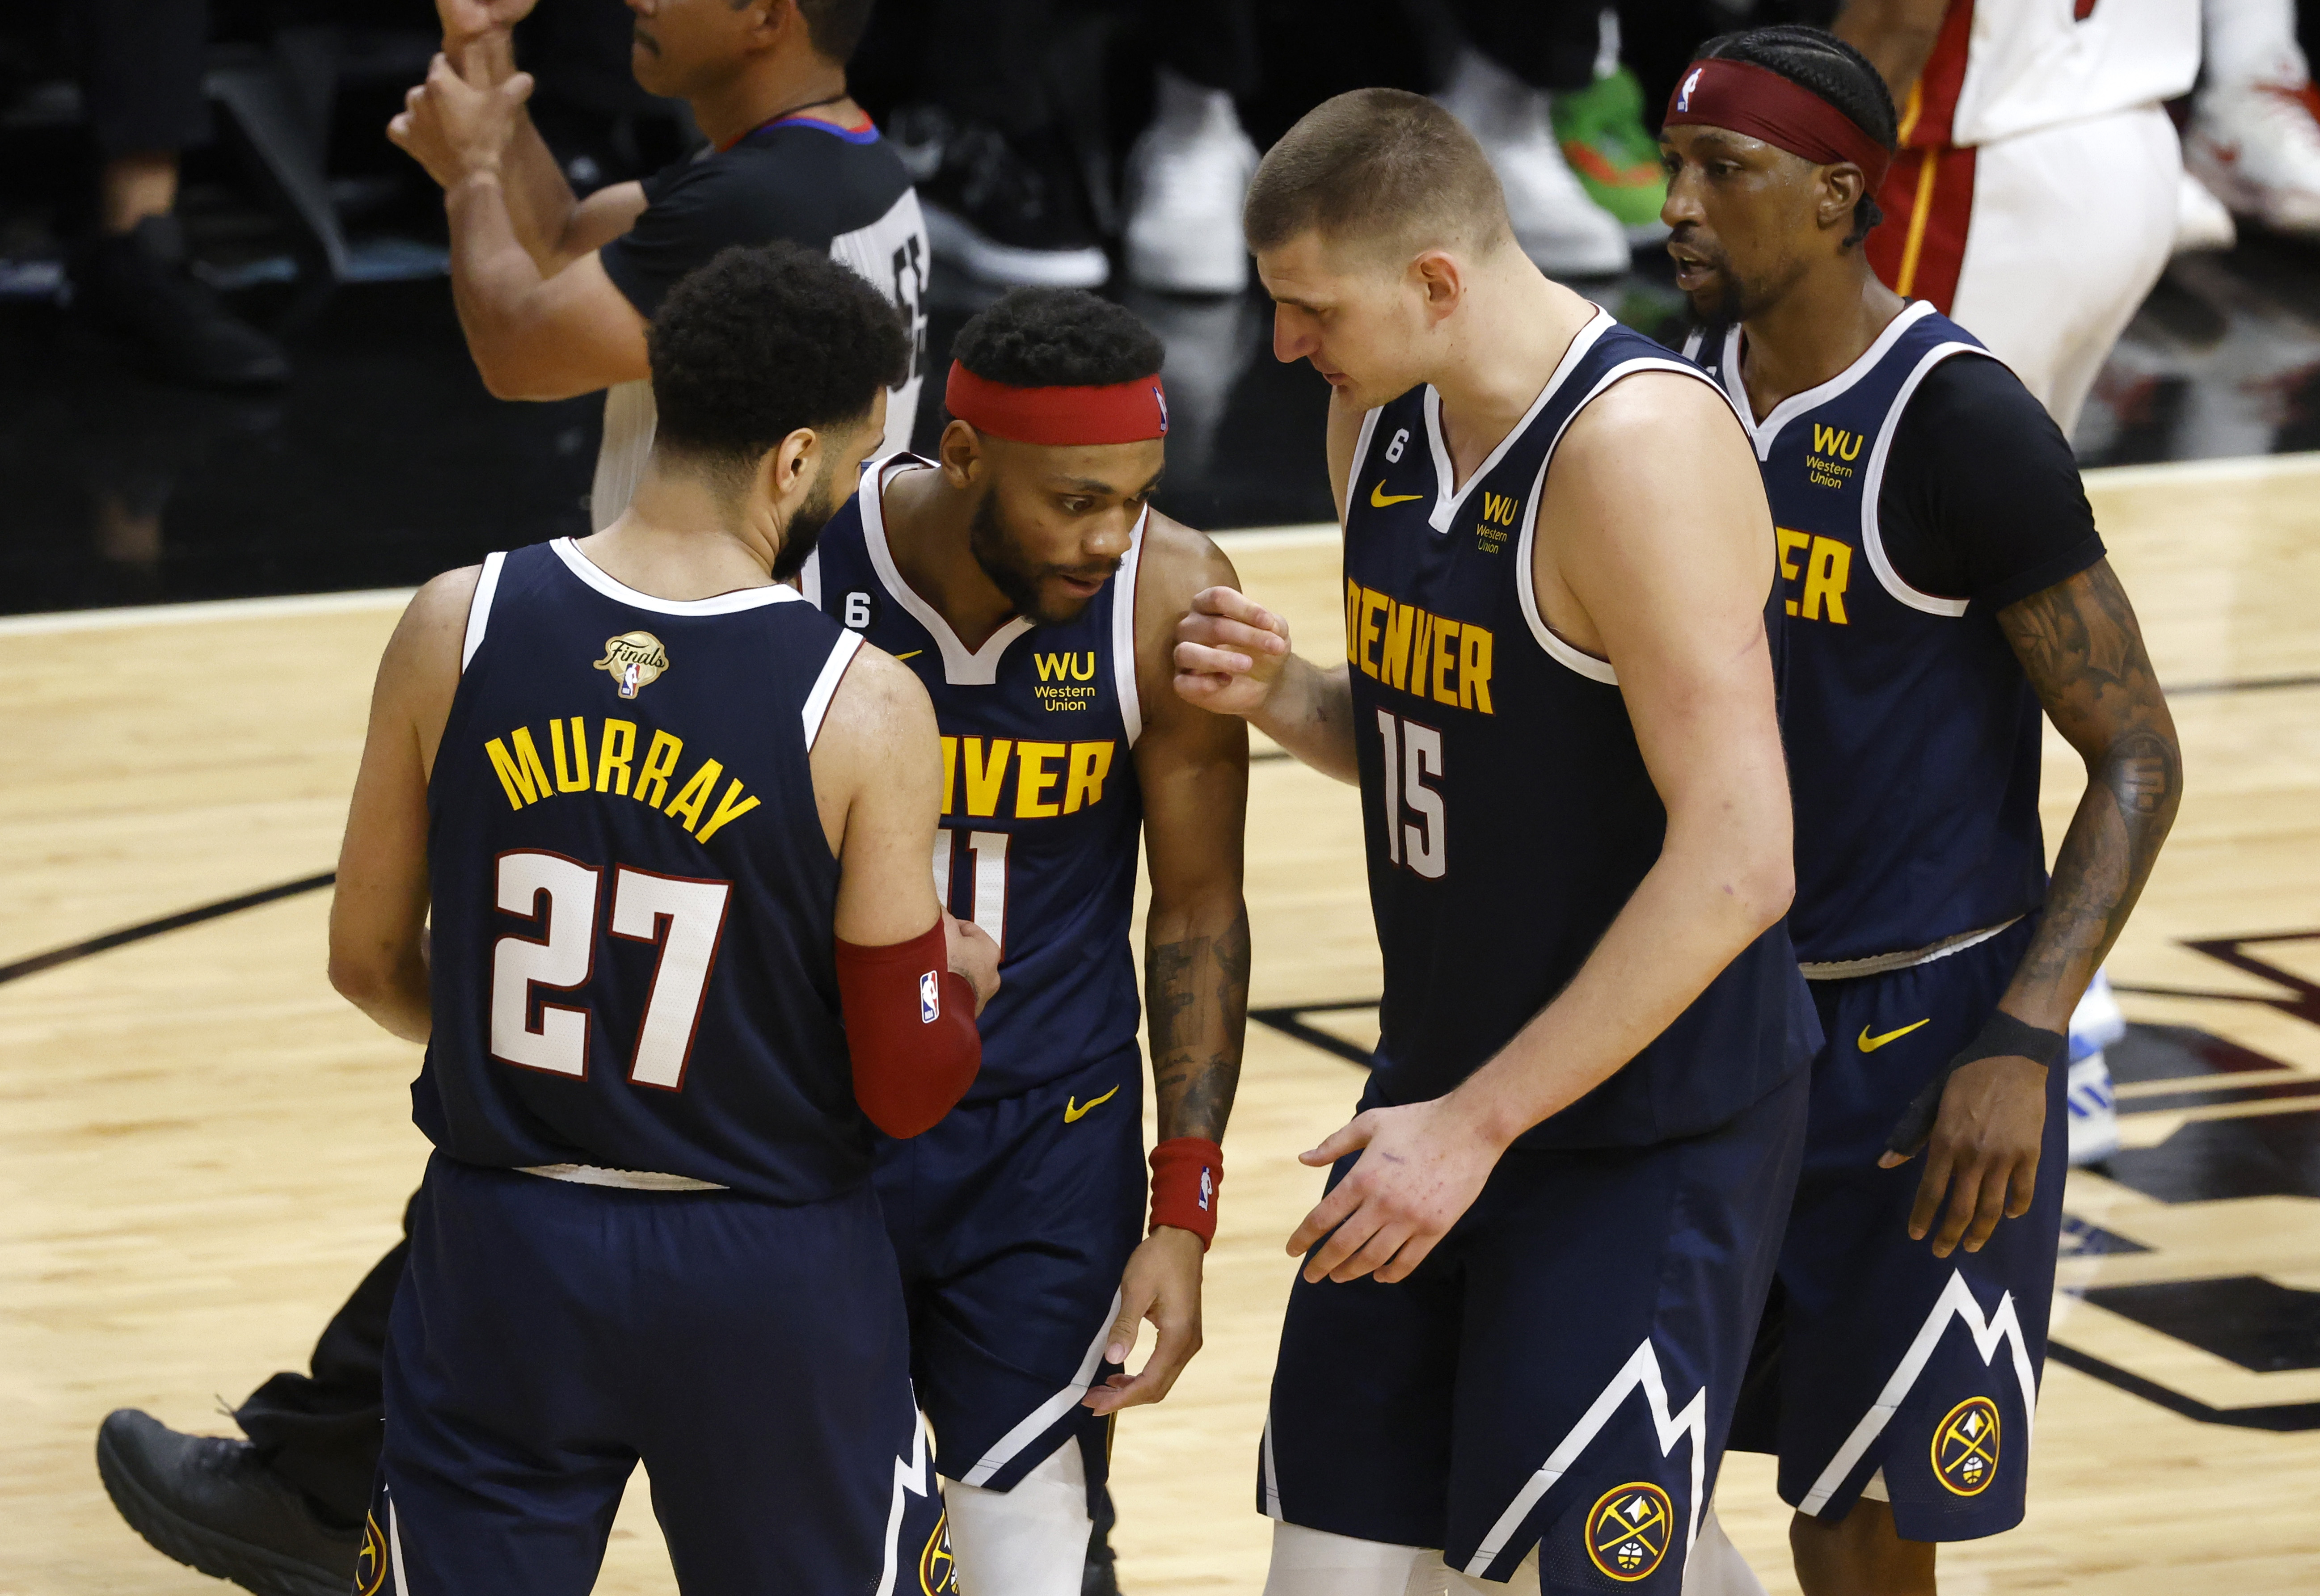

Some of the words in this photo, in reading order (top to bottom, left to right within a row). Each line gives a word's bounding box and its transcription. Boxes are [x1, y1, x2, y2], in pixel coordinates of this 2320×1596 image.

[1386, 428, 1409, 463] 6
[1814, 423, 1863, 461] WU
[1807, 455, 1852, 478] Western
[1810, 471, 1842, 489] Union
[1484, 491, 1519, 526] WU
[1476, 523, 1507, 542] Western
[1478, 538, 1499, 554] Union
[845, 592, 871, 628] 6
[598, 640, 665, 667] Finals
[1346, 576, 1495, 716] DENVER
[1034, 652, 1094, 681] WU
[1034, 685, 1096, 698] Western
[1045, 698, 1086, 712] Union
[485, 716, 761, 844] MURRAY
[1376, 706, 1447, 881] 15
[488, 848, 734, 1093] 27
